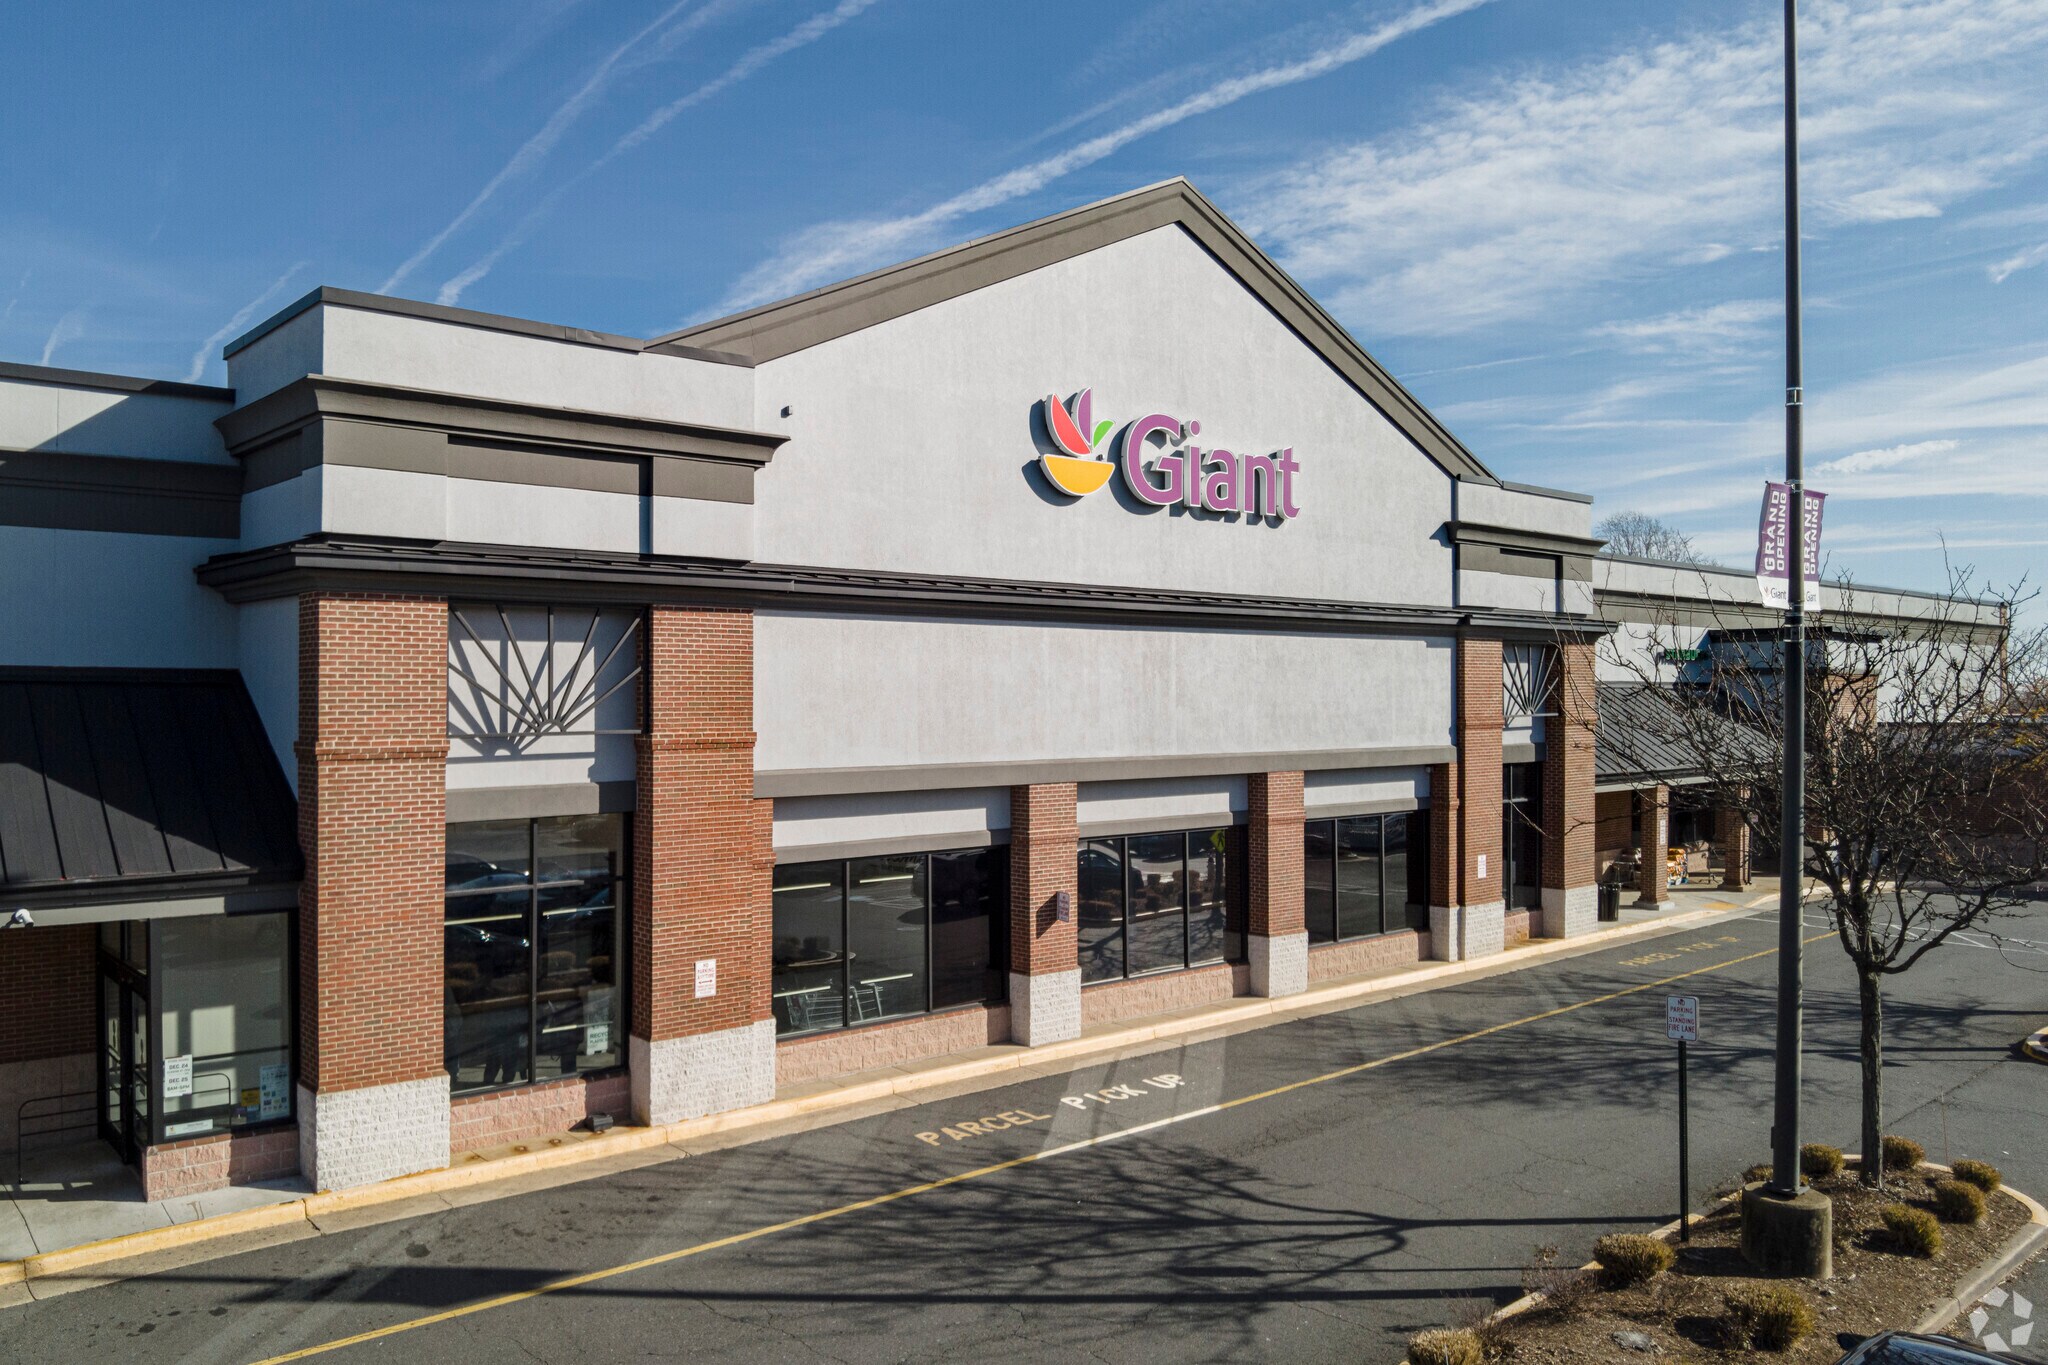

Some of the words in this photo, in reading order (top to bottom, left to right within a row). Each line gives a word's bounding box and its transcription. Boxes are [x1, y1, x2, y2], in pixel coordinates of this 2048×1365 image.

[1122, 413, 1302, 519] Giant
[1764, 491, 1780, 571] GRAND
[1776, 492, 1787, 571] OPENING
[1803, 497, 1812, 574] GRAND
[1810, 499, 1819, 575] OPENING
[1770, 587, 1787, 600] Giant
[1669, 1016, 1695, 1025] STANDING
[1669, 1024, 1680, 1032] FIRE
[1681, 1025, 1695, 1034] LANE
[1670, 1006, 1693, 1014] PARKING
[914, 1109, 1053, 1146] PARCEL
[1060, 1083, 1148, 1110] PICK
[1142, 1073, 1185, 1089] UP
